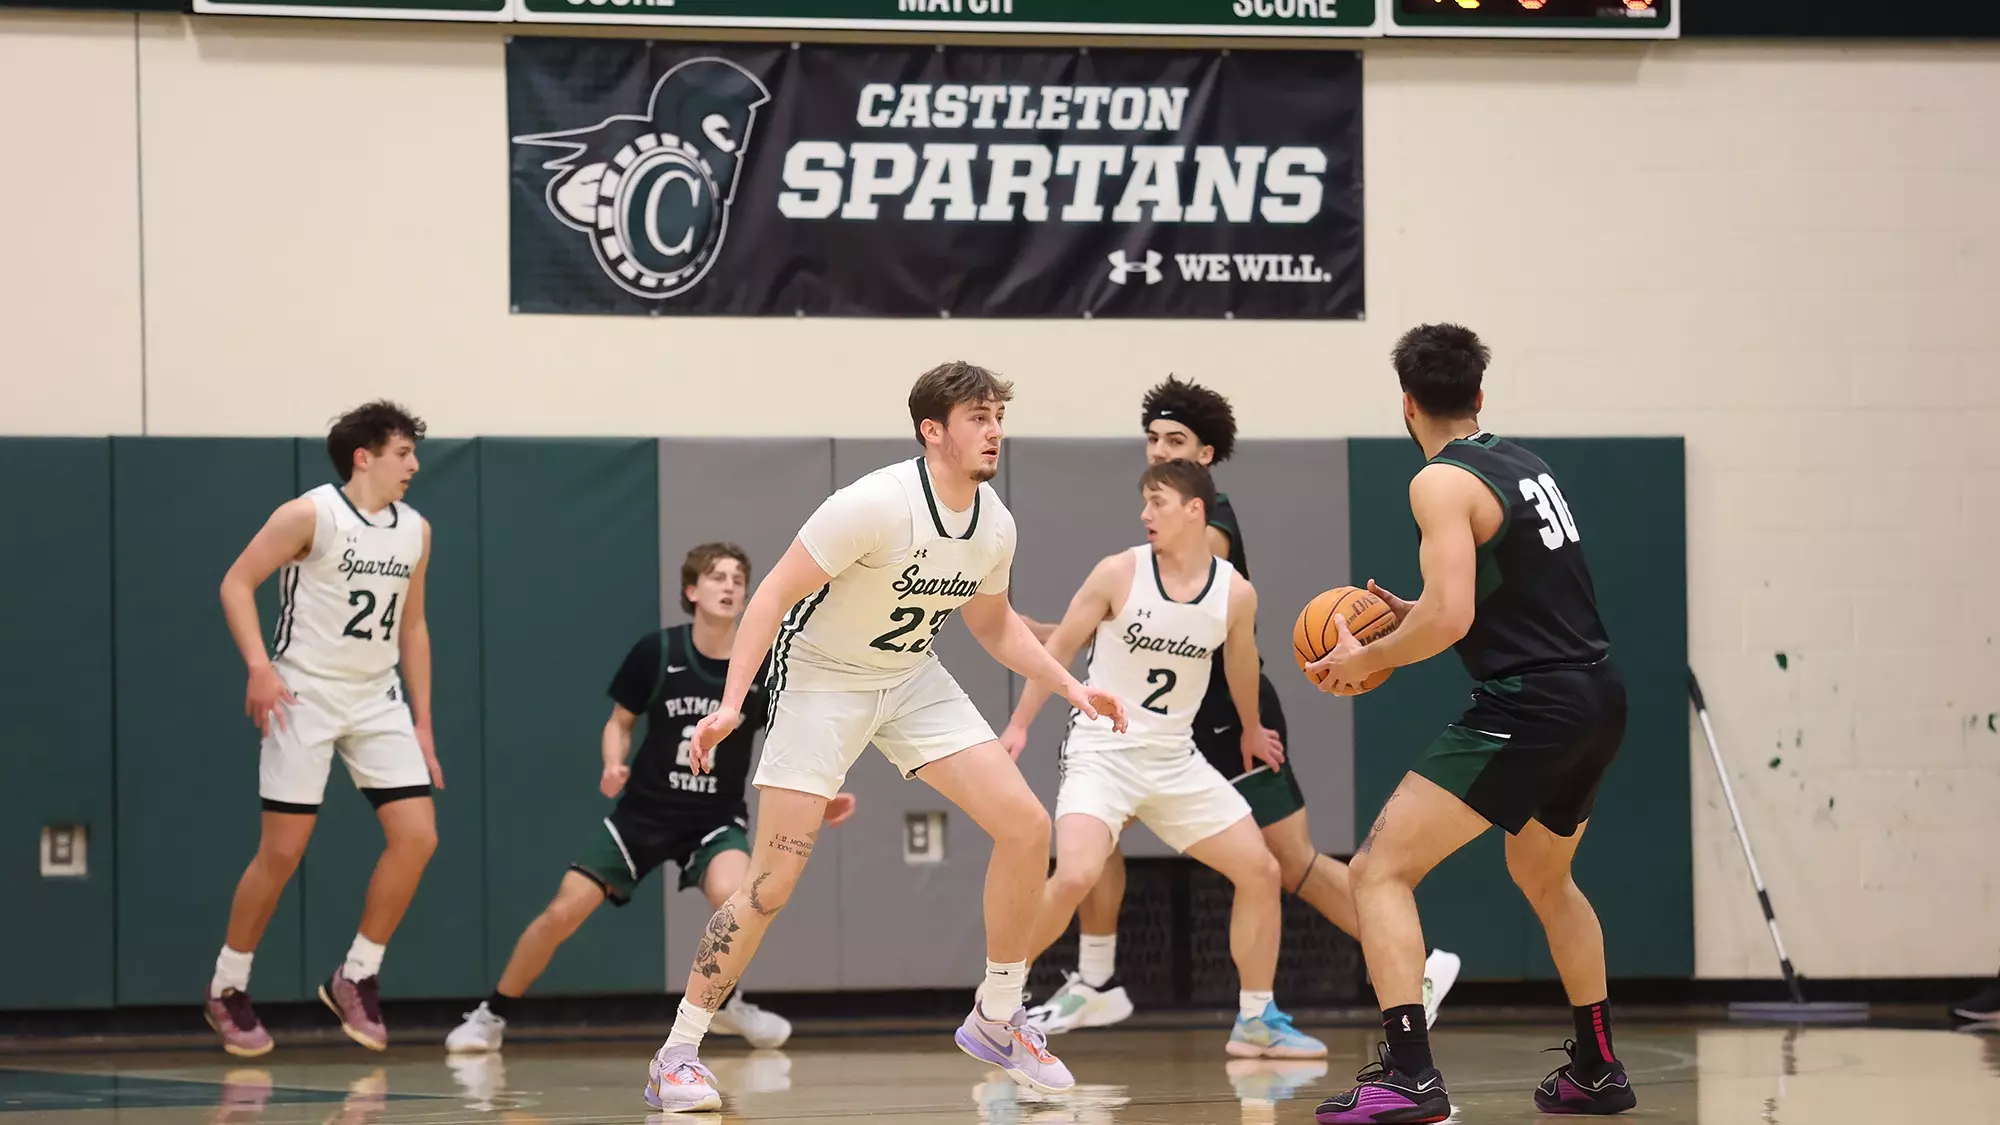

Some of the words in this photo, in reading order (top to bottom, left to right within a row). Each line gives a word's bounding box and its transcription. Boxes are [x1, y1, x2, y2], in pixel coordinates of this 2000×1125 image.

[856, 83, 1189, 131] CASTLETON
[777, 141, 1329, 224] SPARTANS
[644, 169, 701, 257] C
[1174, 253, 1231, 282] WE
[1232, 253, 1333, 282] WILL.
[1518, 472, 1580, 550] 30
[337, 548, 411, 581] Spartan
[891, 564, 984, 600] Spartan
[342, 589, 399, 641] 24
[1122, 622, 1213, 660] Spartan
[1141, 668, 1177, 715] 2
[675, 725, 719, 771] 2
[668, 771, 718, 794] STATE
